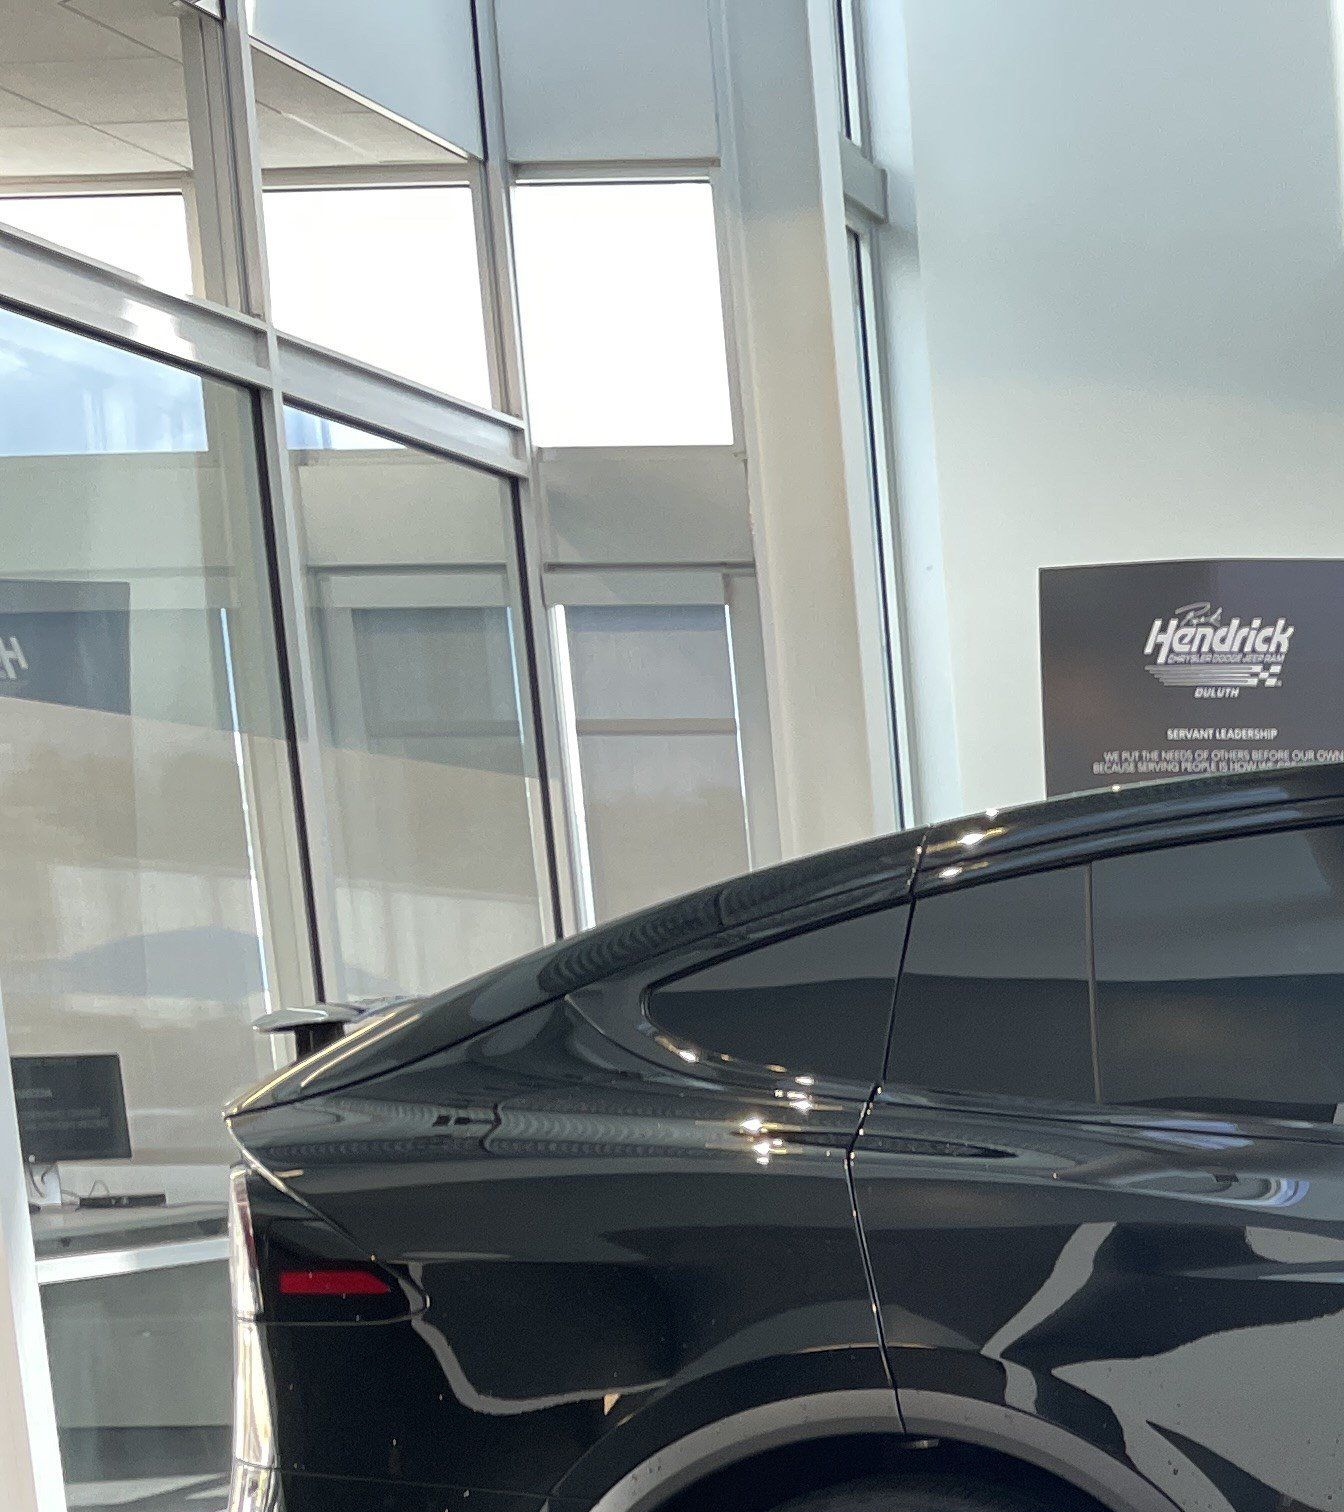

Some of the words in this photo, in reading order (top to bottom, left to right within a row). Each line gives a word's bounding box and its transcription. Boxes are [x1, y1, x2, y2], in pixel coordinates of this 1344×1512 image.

[1143, 617, 1295, 665] Hendrick
[1194, 687, 1240, 698] DULUTH
[1167, 728, 1214, 740] SERVANT
[1216, 728, 1278, 740] LEADERSHIP
[1103, 750, 1120, 761] WE
[1121, 750, 1140, 761] PUT
[1142, 750, 1160, 761] THE
[1161, 750, 1193, 761] NEEDS
[1194, 750, 1209, 761] OF
[1211, 750, 1250, 761] OTHERS
[1251, 750, 1290, 761] BEFORE
[1291, 750, 1315, 761] OUR
[1317, 750, 1344, 761] OWN
